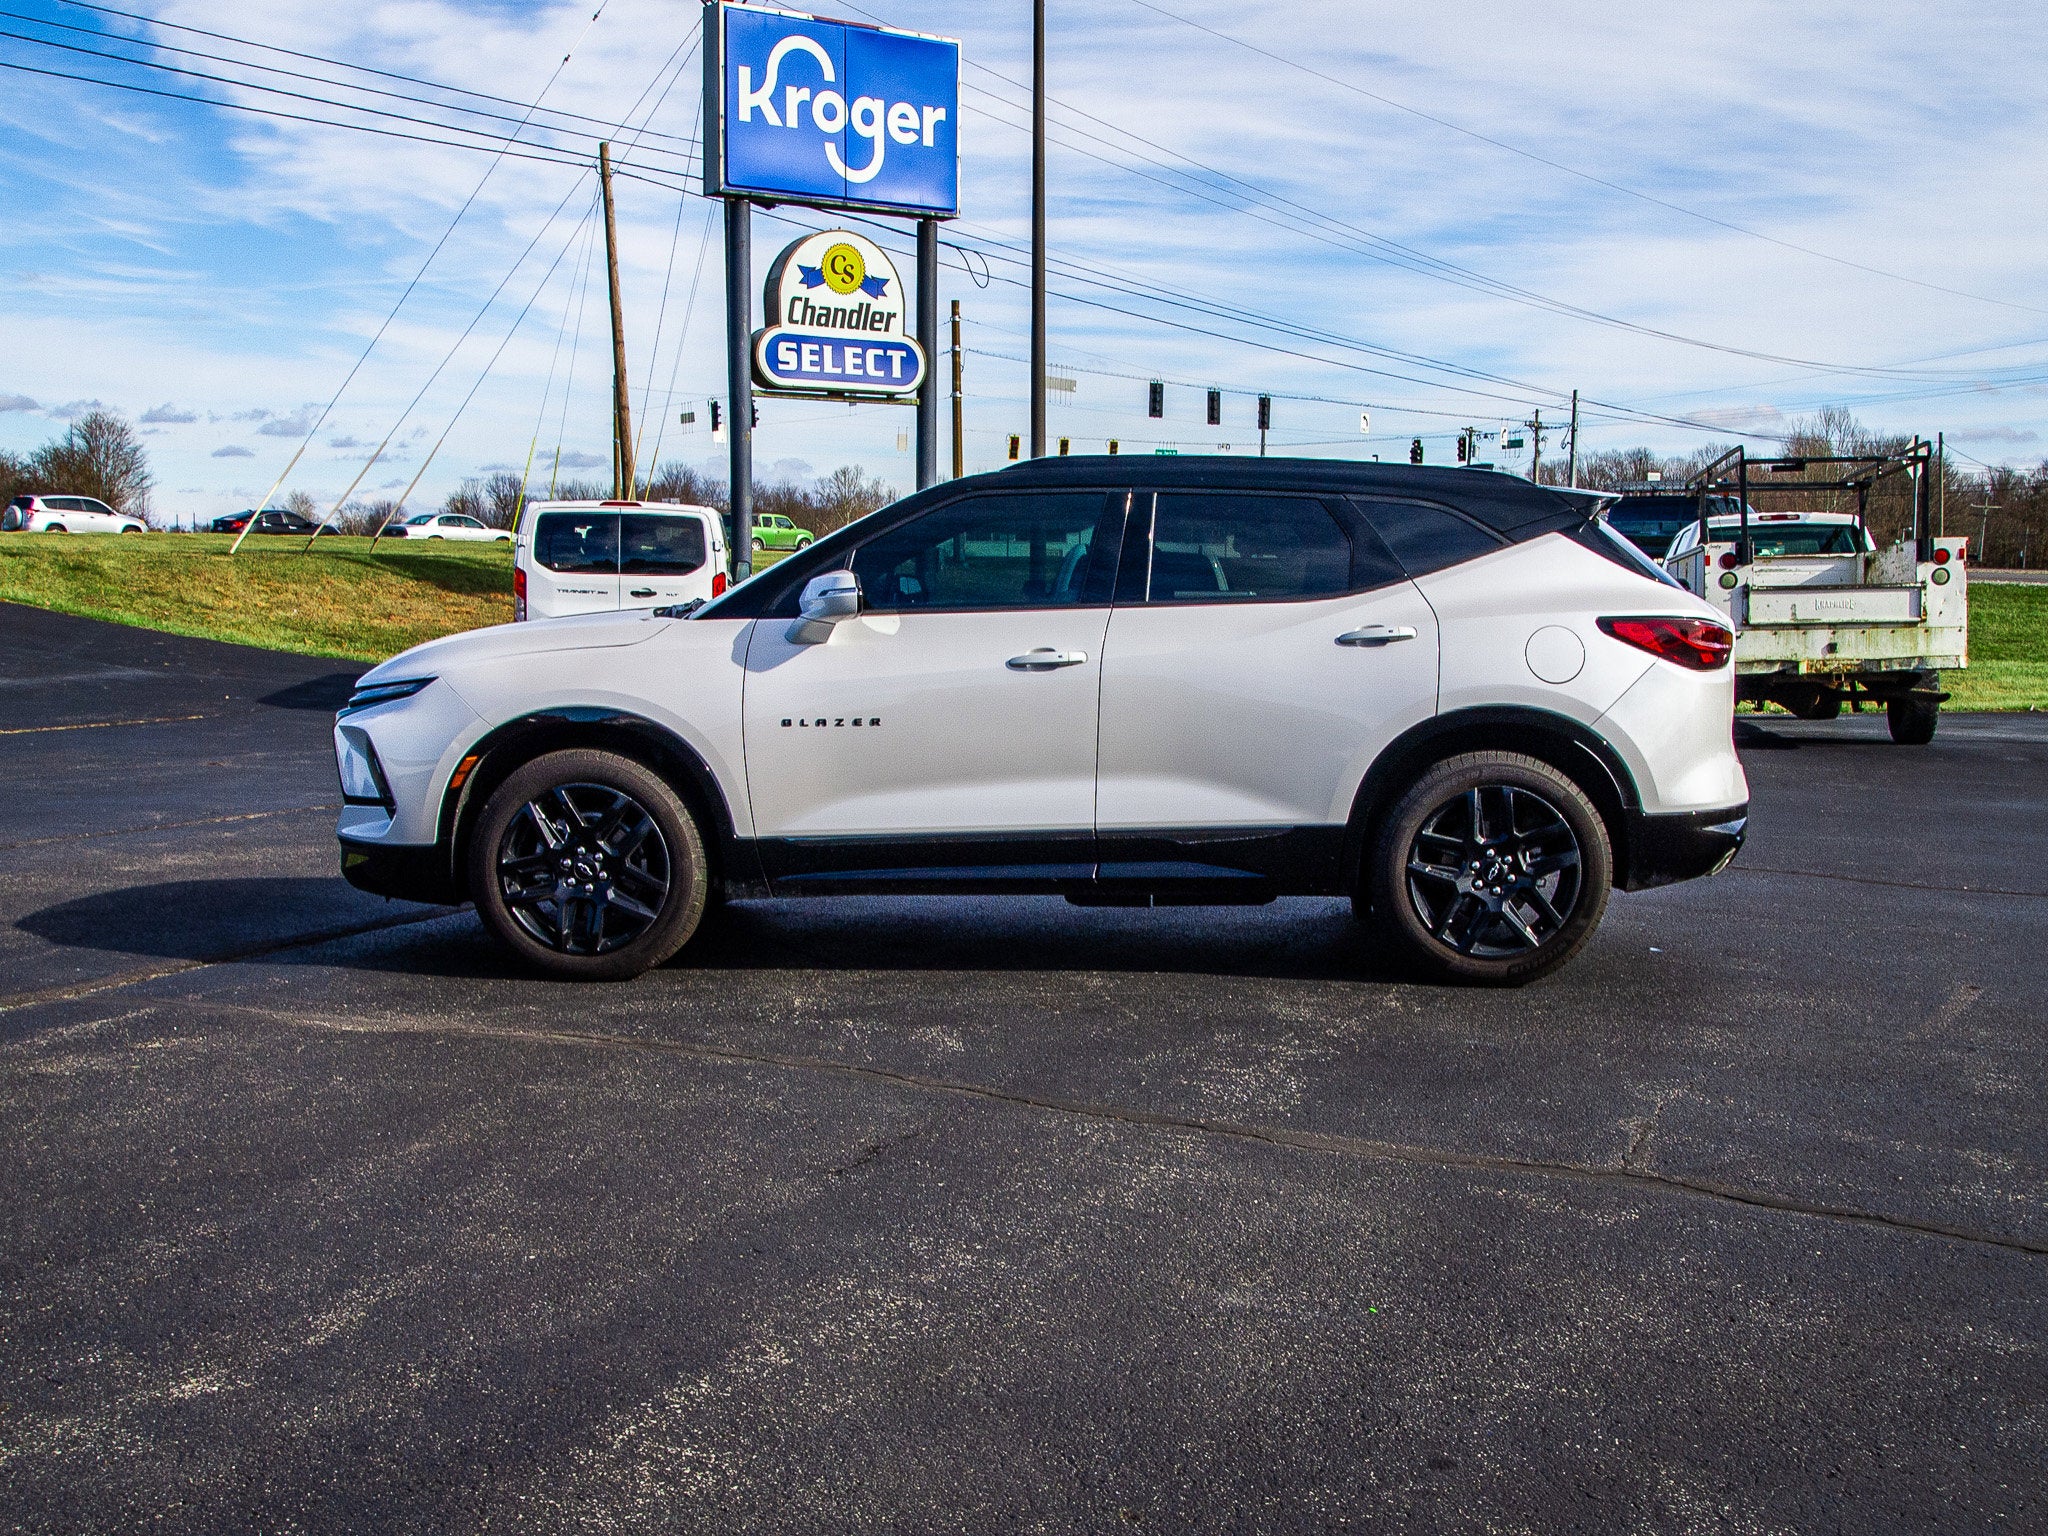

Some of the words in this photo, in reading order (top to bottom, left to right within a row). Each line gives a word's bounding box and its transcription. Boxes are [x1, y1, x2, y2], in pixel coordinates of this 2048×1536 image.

[738, 35, 946, 184] Kroger
[788, 296, 897, 333] Chandler
[777, 341, 907, 379] SELECT
[780, 718, 881, 728] BLAZER
